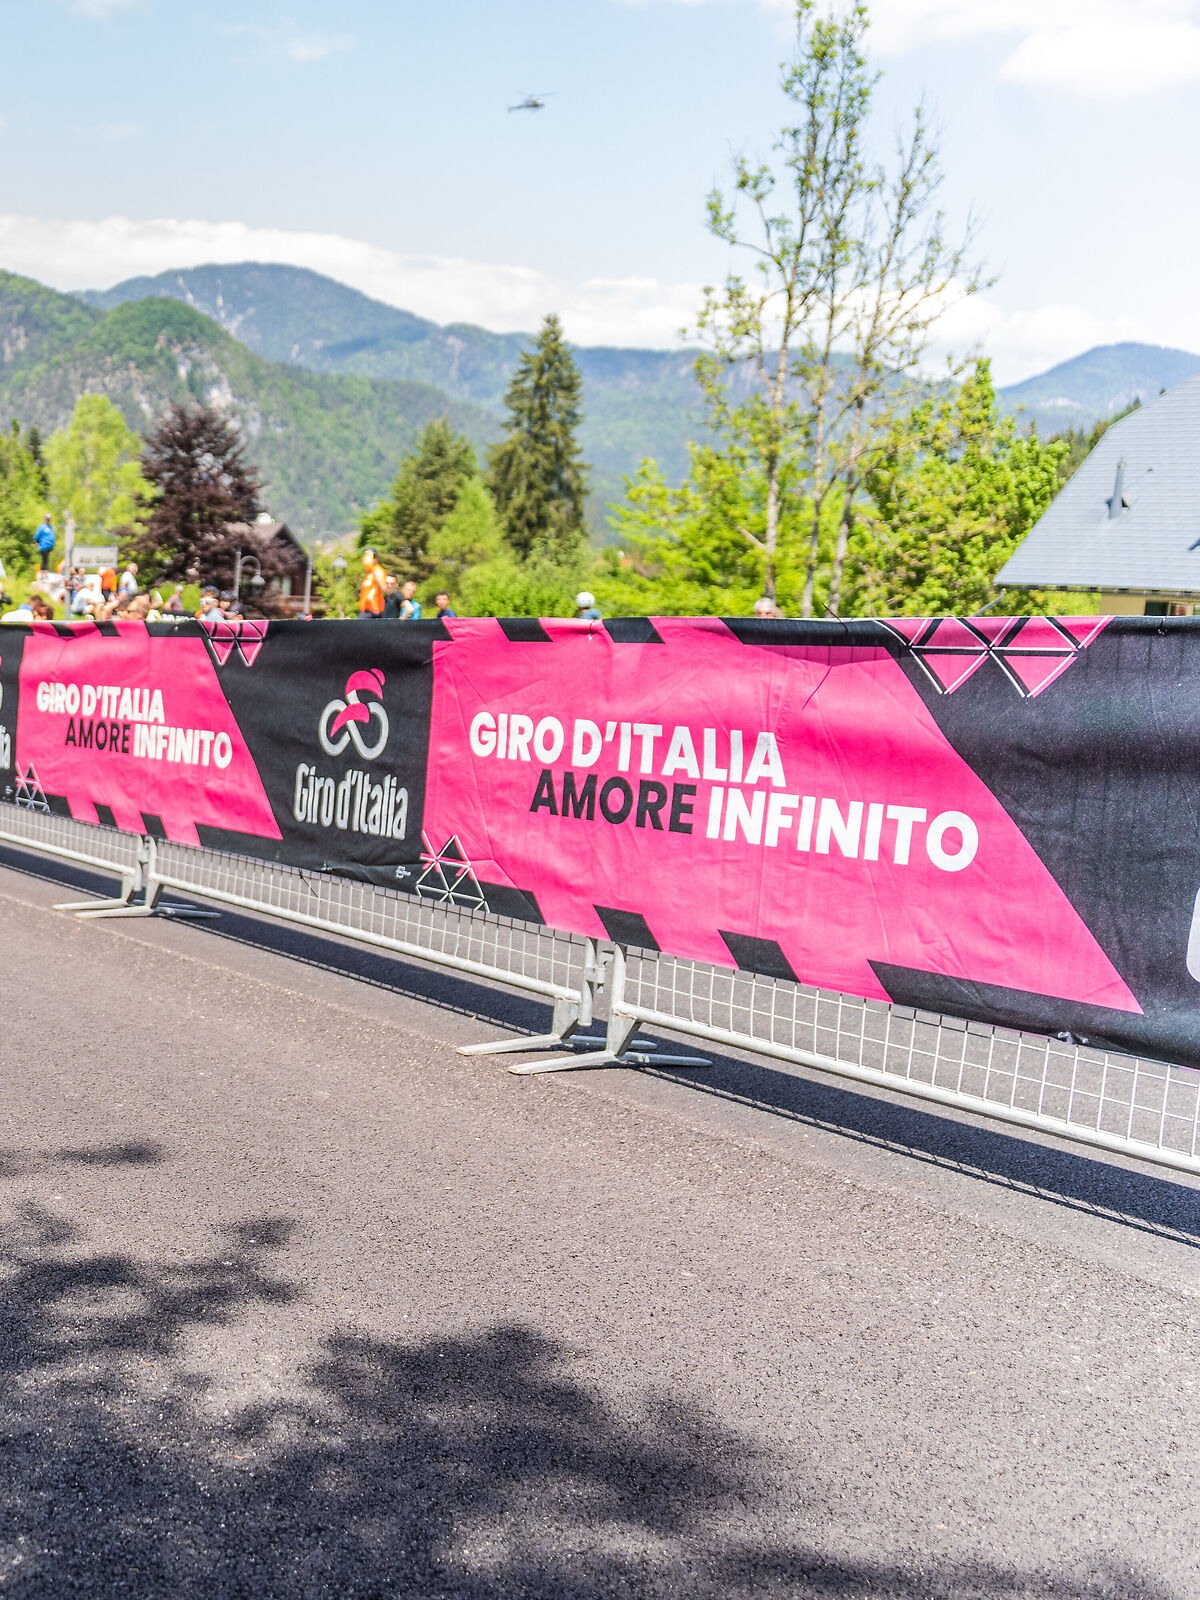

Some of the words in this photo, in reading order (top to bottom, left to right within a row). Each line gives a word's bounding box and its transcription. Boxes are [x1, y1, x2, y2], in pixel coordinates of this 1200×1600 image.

[36, 681, 80, 714] GIRO
[65, 718, 130, 754] AMORE
[133, 723, 233, 769] INFINITO
[469, 711, 565, 764] GIRO
[293, 762, 335, 828] Giro
[529, 769, 697, 834] AMORE
[706, 786, 980, 873] INFINITO
